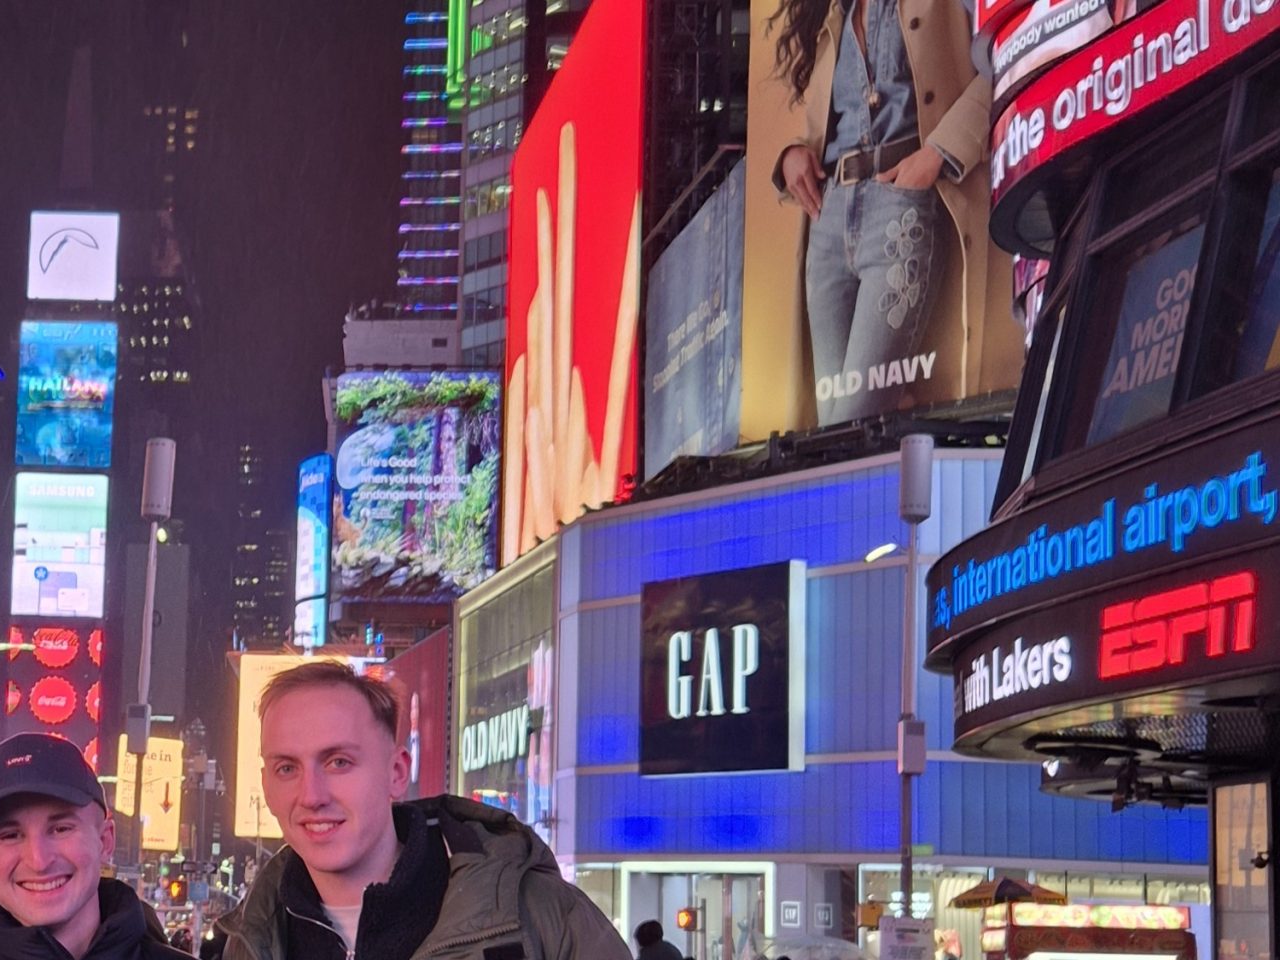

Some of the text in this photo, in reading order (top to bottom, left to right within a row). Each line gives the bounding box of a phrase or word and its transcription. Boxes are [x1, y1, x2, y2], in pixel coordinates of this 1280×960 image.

[1007, 106, 1045, 167] the
[1051, 0, 1210, 131] original
[815, 351, 937, 402] OLD NAVY
[29, 484, 95, 497] SAMSUNG
[359, 490, 423, 503] endangered
[360, 473, 471, 486] when you help protect
[388, 457, 417, 468] Good
[952, 496, 1117, 617] international
[1122, 450, 1278, 552] airport,
[1099, 571, 1257, 680] ESPN
[667, 623, 760, 720] GAP
[963, 635, 1073, 714] with Lakers
[462, 703, 529, 773] OLD NAVY
